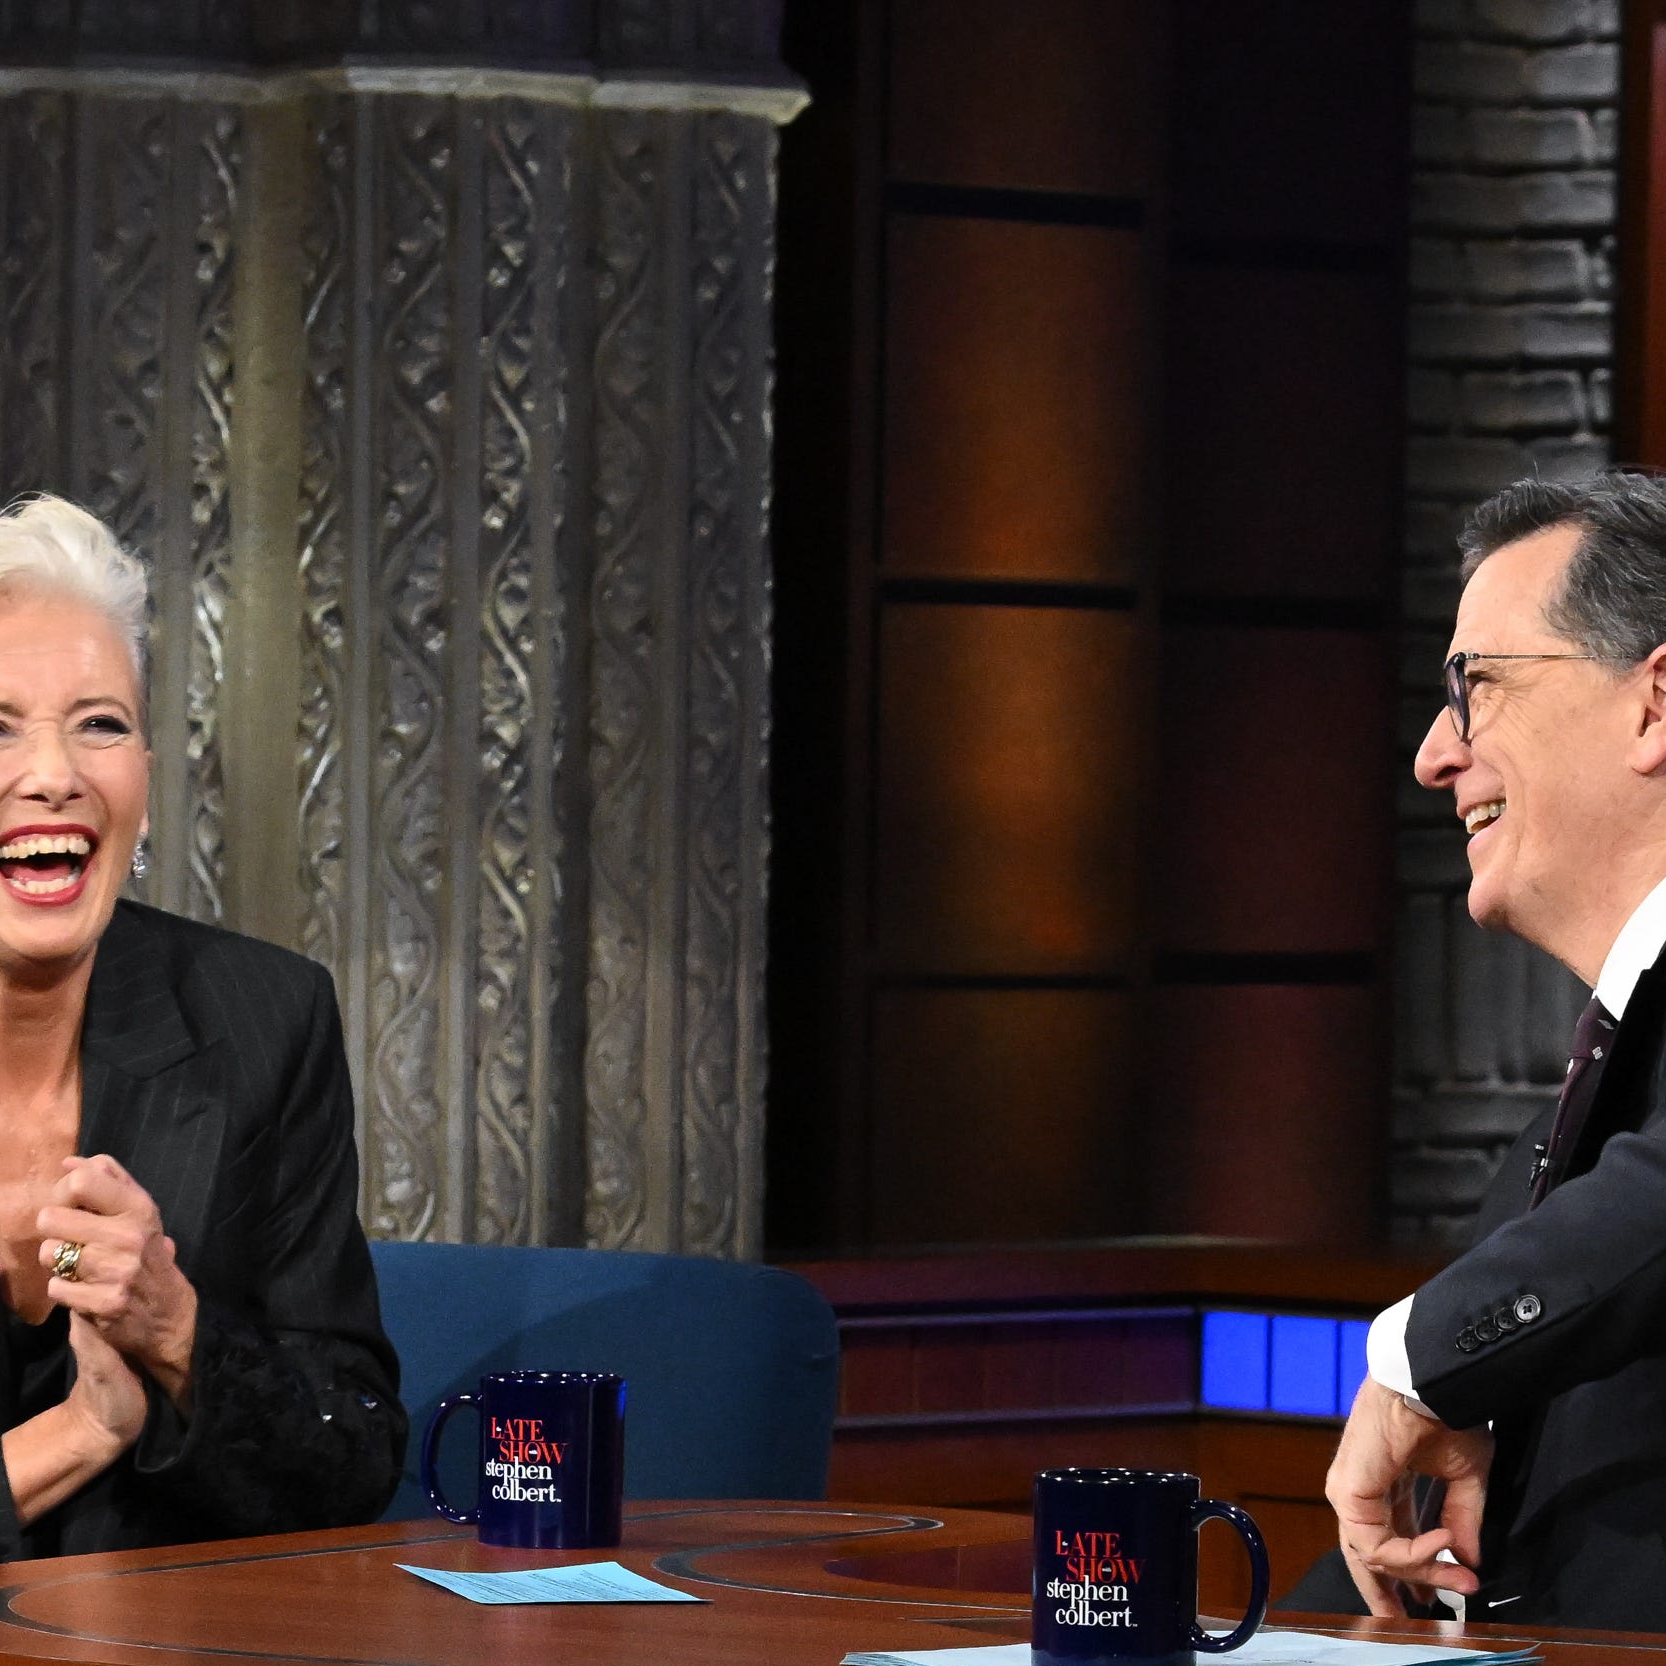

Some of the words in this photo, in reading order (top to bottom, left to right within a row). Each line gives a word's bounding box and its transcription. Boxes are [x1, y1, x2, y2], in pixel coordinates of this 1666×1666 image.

[490, 1416, 545, 1442] LATE
[498, 1439, 569, 1465] SHOW
[485, 1455, 553, 1487] stephen
[1054, 1529, 1123, 1558] LATE
[1065, 1556, 1146, 1585] SHOW
[1046, 1574, 1129, 1610] stephen
